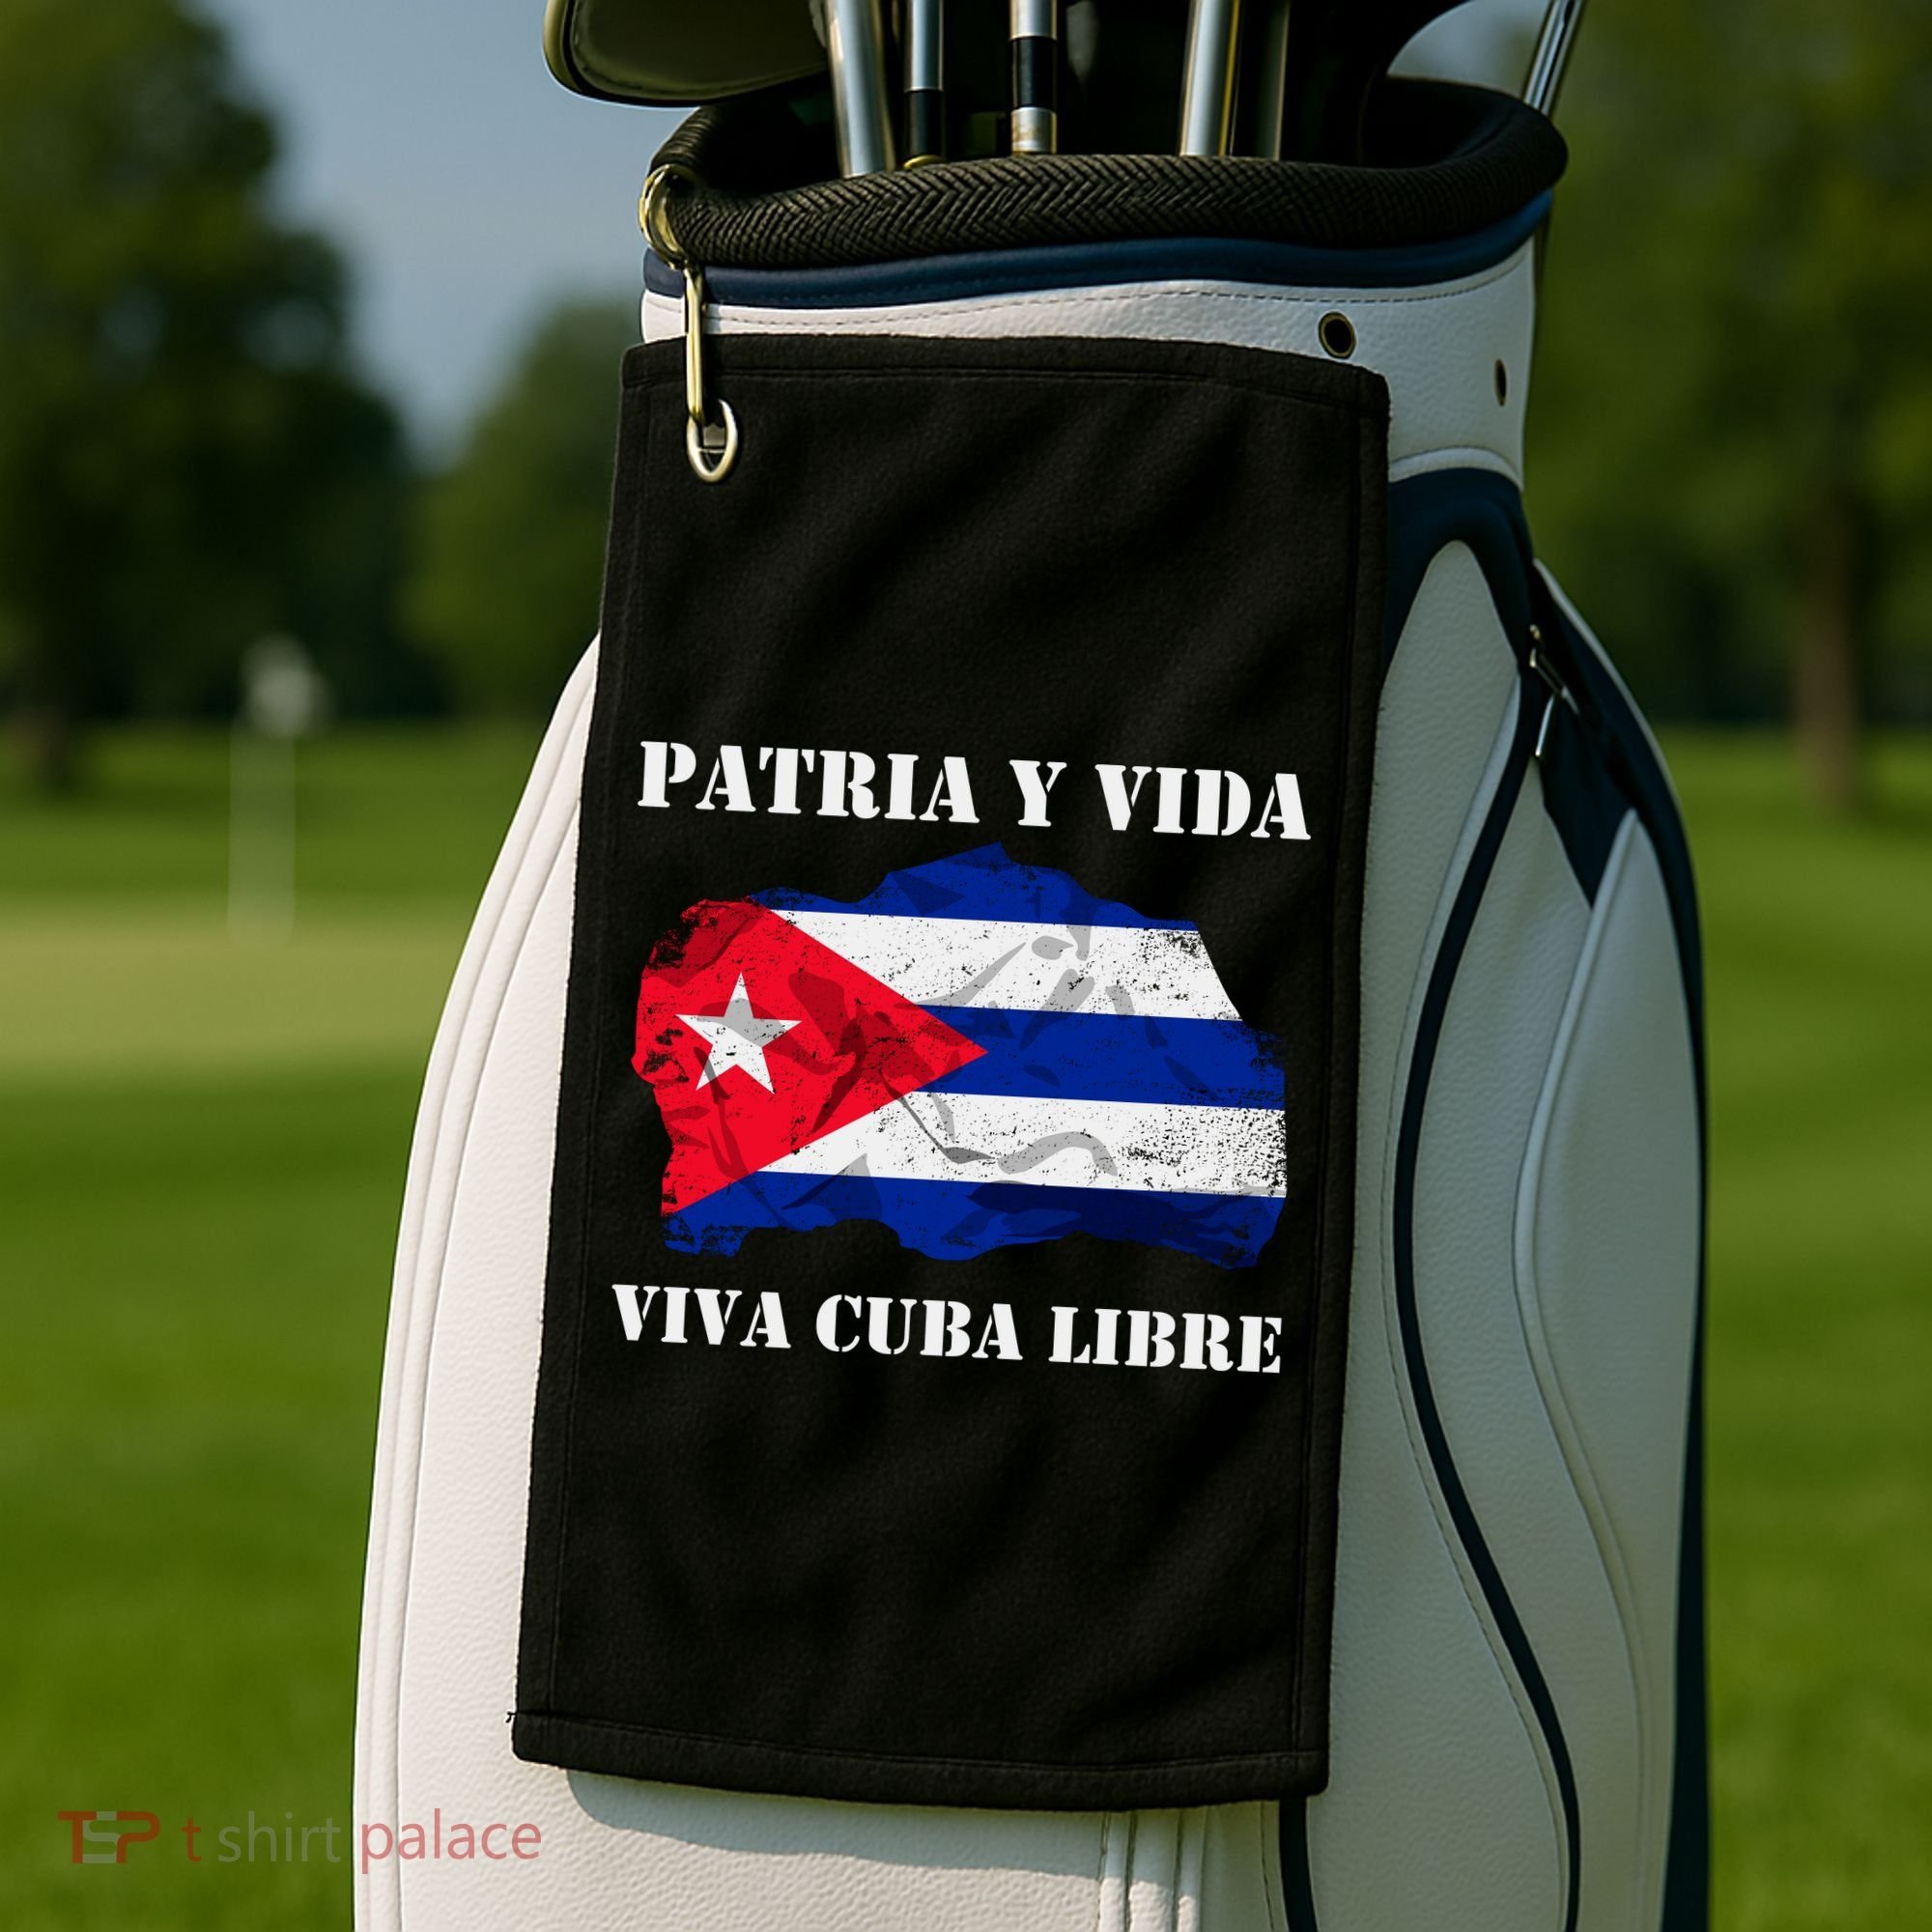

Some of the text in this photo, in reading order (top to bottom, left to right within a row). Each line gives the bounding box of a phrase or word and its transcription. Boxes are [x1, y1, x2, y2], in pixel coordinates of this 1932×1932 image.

[637, 740, 1312, 842] PATRIA Y VIDA
[611, 1284, 1283, 1374] VIVA CUBA LIBRE
